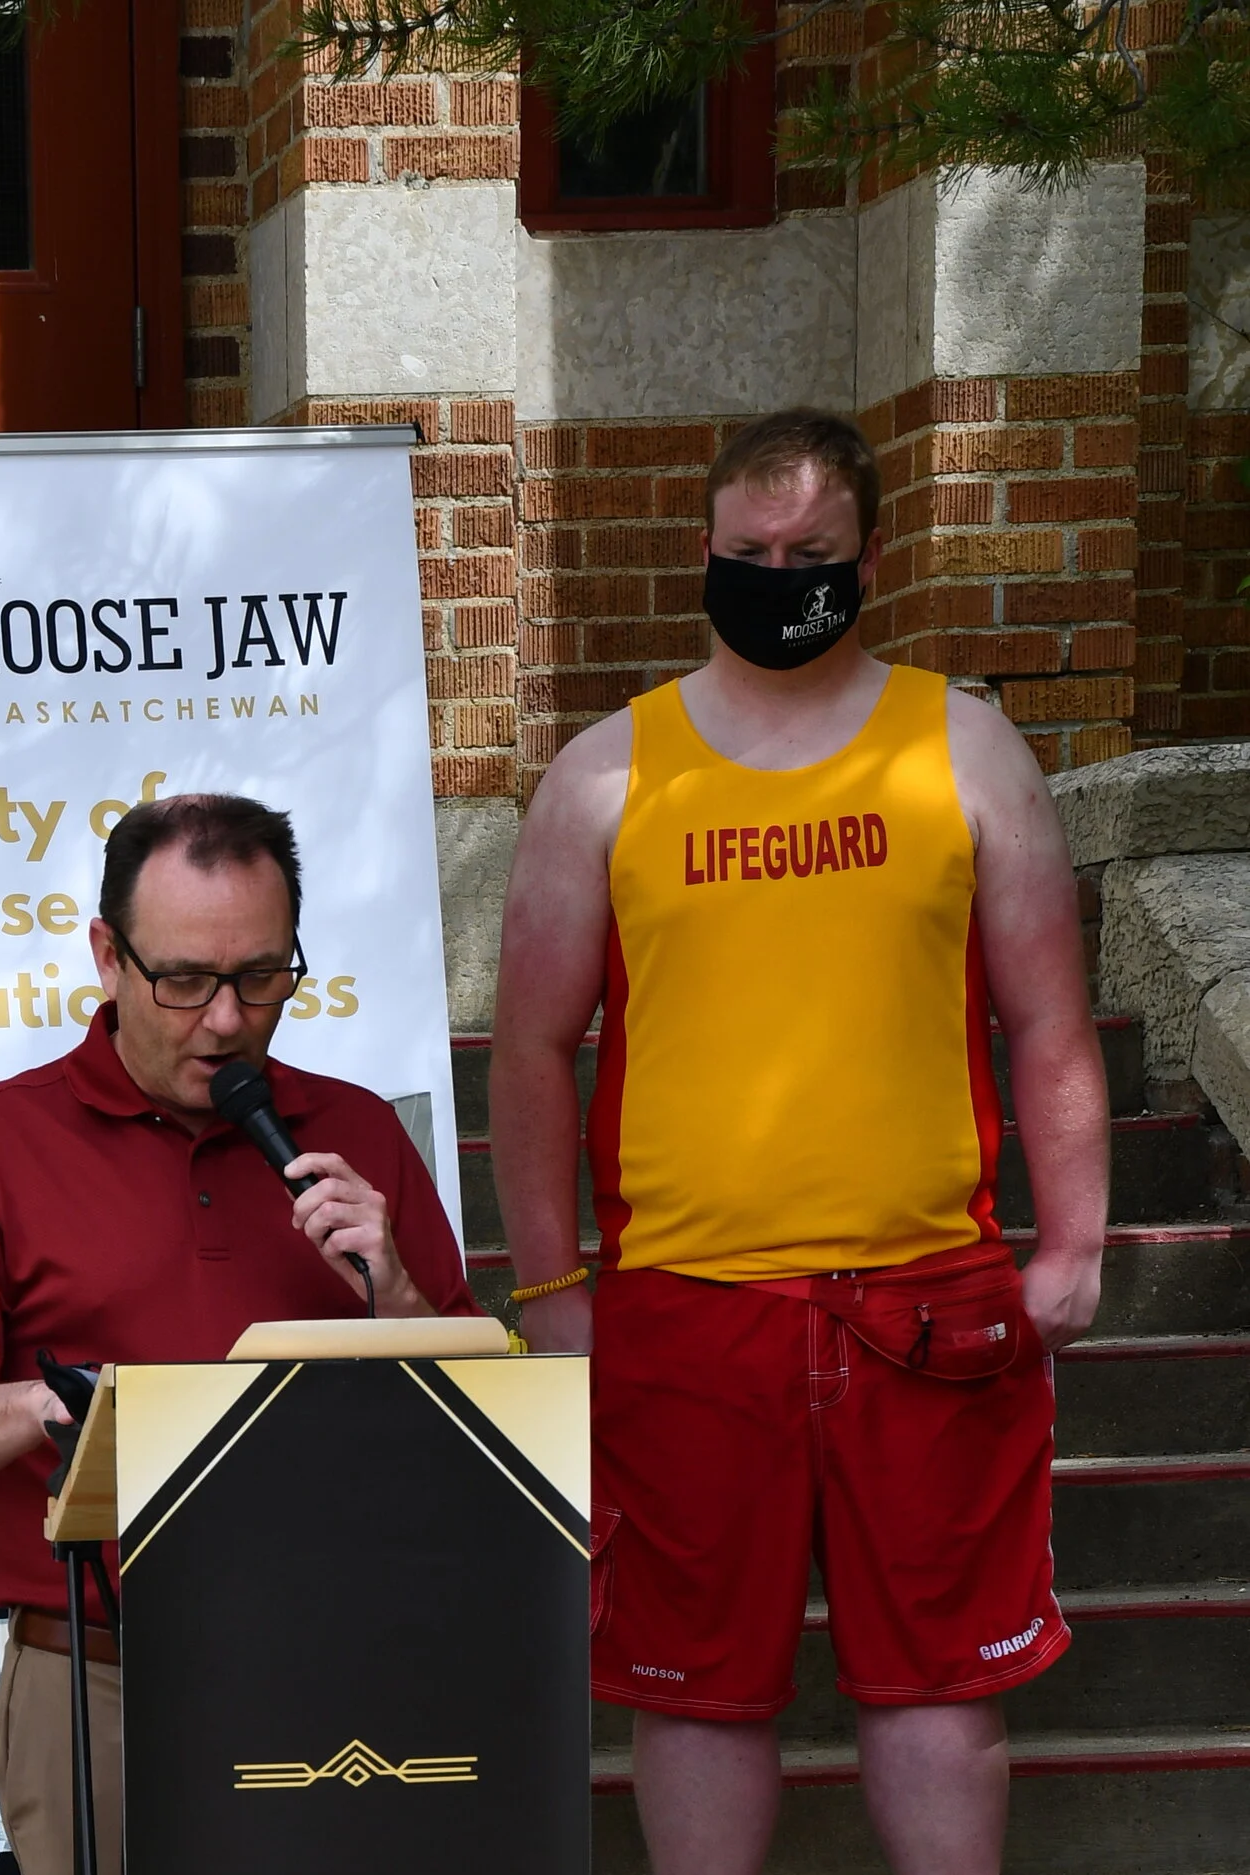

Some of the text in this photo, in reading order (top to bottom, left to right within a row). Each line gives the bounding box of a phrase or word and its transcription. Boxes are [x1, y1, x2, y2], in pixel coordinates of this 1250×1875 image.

[204, 591, 348, 680] JAW
[782, 619, 825, 640] MOOSE
[685, 813, 888, 886] LIFEGUARD
[289, 976, 359, 1019] ss
[979, 1629, 1034, 1661] GUARD
[632, 1663, 685, 1682] HUDSON
